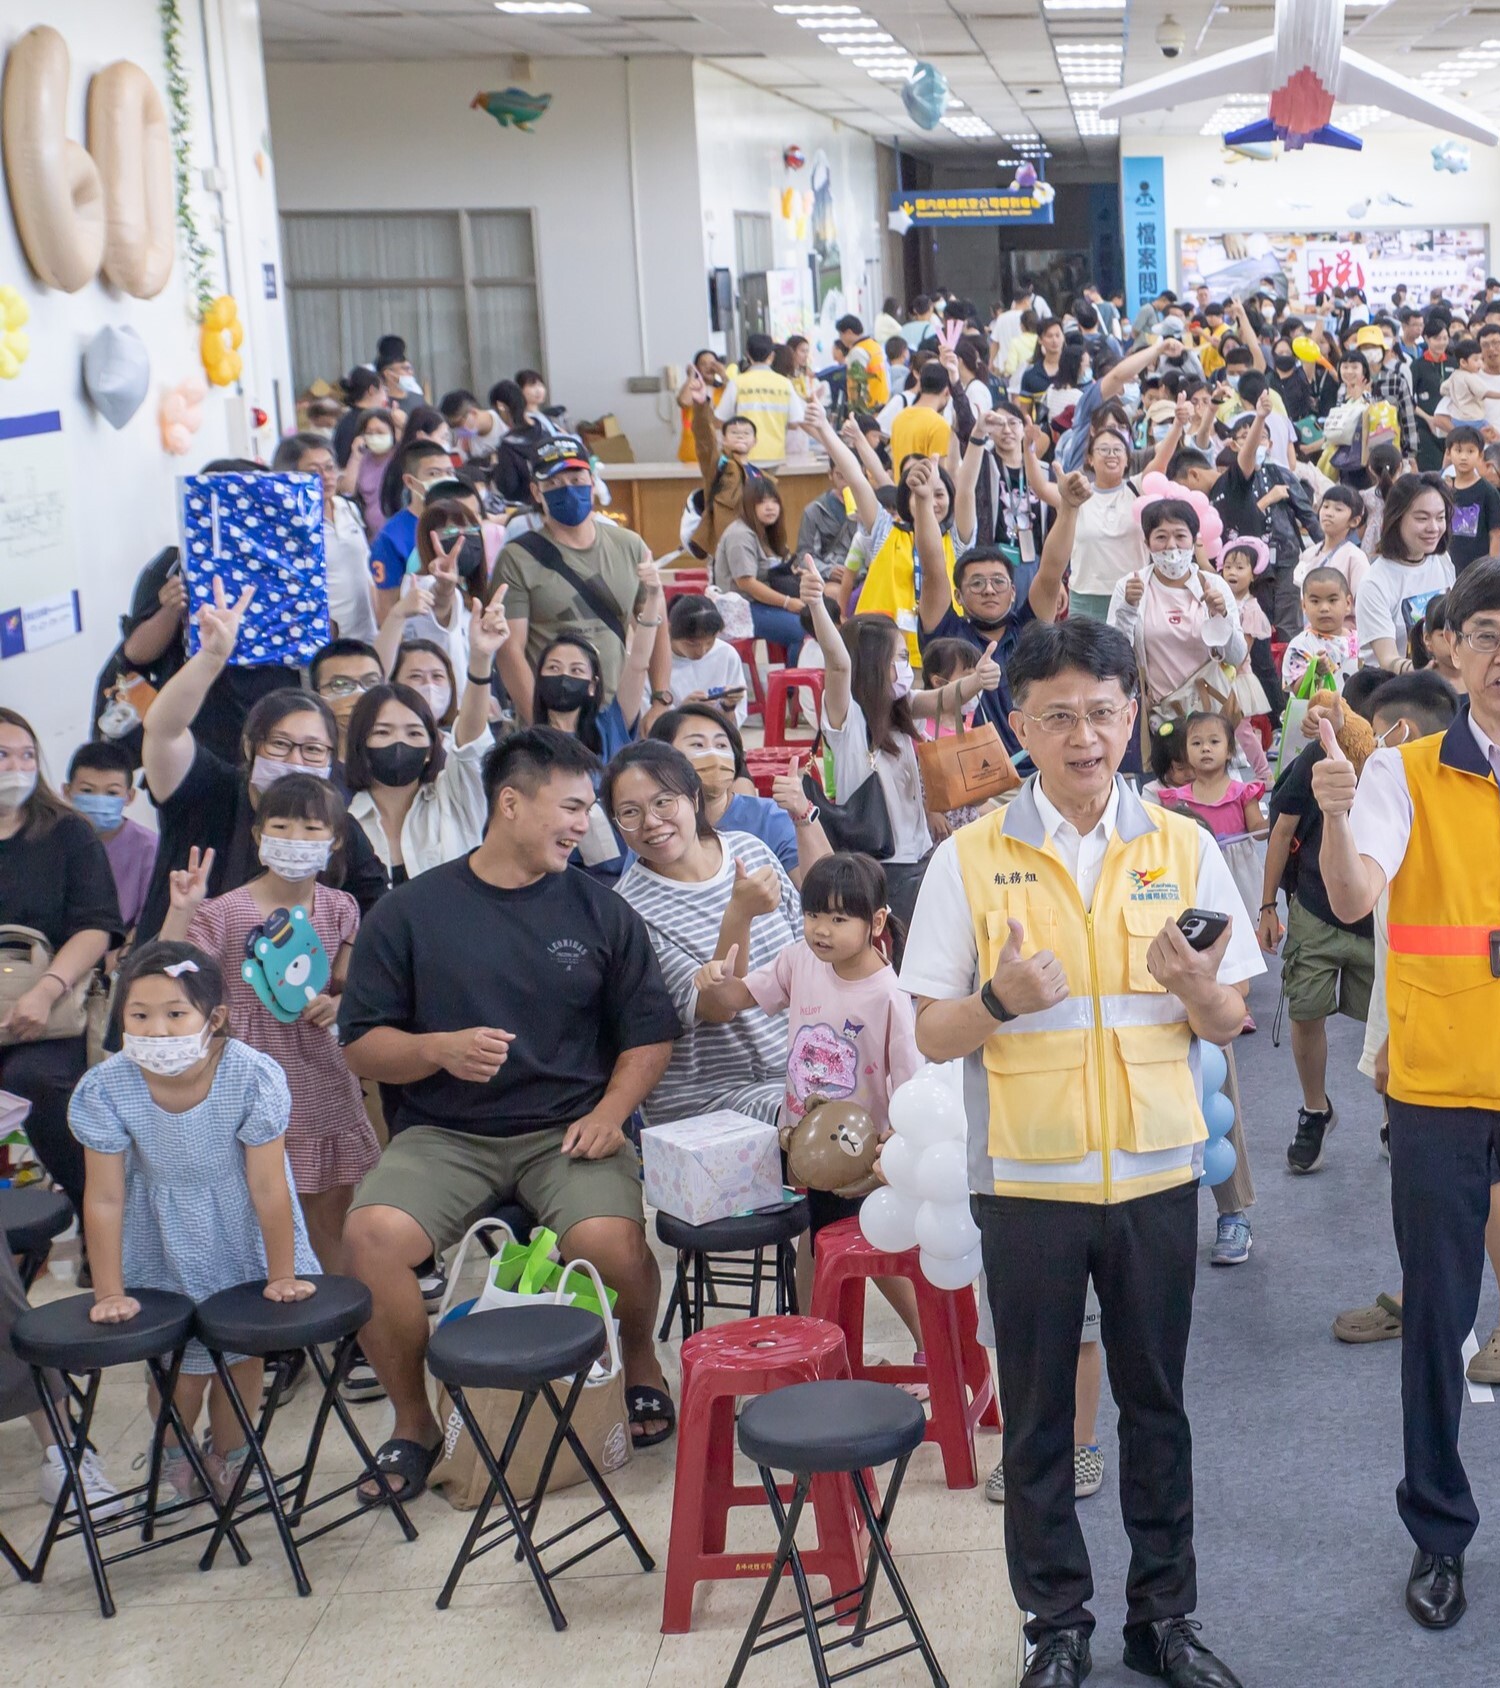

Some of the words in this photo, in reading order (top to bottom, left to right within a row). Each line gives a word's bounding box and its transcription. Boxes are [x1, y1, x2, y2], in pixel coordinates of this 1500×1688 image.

[372, 560, 384, 583] 3
[994, 871, 1038, 885] 航務組
[547, 939, 588, 955] LEONIDAS
